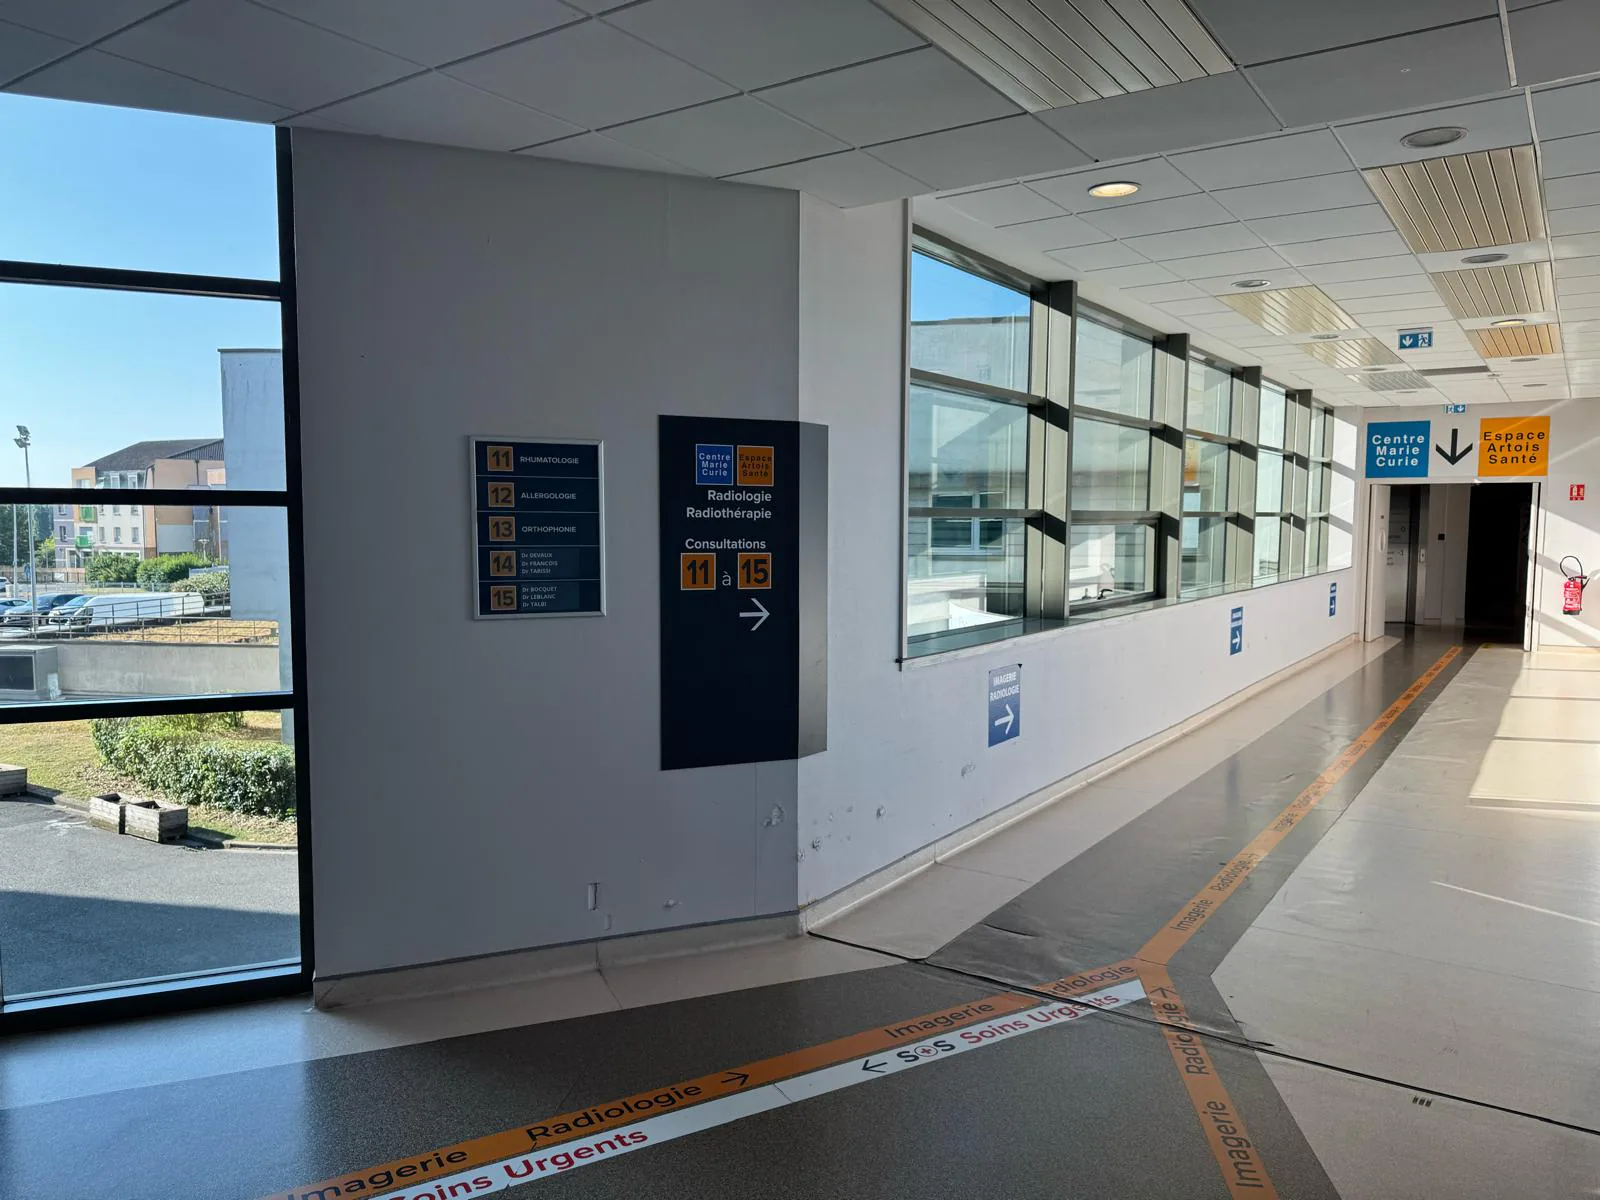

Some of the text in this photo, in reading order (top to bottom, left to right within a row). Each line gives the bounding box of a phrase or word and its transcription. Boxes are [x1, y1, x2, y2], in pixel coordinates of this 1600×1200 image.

[1371, 434, 1425, 445] Centre
[1483, 431, 1546, 443] Espace
[1376, 445, 1420, 456] Marie
[1487, 442, 1540, 453] Artois
[491, 450, 580, 468] 11 RHUMATOLOGIE
[698, 452, 731, 461] Centre
[1375, 456, 1419, 467] Curie
[1488, 453, 1537, 464] Santé
[701, 461, 728, 469] Marie
[702, 469, 728, 477] Curie
[491, 487, 577, 504] 12 ALLERGOLOGIE
[707, 489, 772, 504] Radiologie
[686, 506, 772, 520] Radiothérapie
[492, 521, 513, 538] 13
[685, 538, 767, 550] Consultations
[492, 556, 514, 573] 14
[687, 558, 769, 586] 11 à 15
[493, 590, 514, 607] 15
[993, 671, 1017, 687] IMAGERIE
[990, 684, 1020, 702] RADIOLOGIE
[884, 1003, 995, 1039] Imagerie
[959, 1019, 1029, 1044] Soins
[1026, 995, 1120, 1024] Urgets
[1156, 1002, 1265, 1189] Imagerie Radiolgie
[526, 1084, 702, 1143] Radiologie
[391, 1129, 649, 1200] oins Urgents
